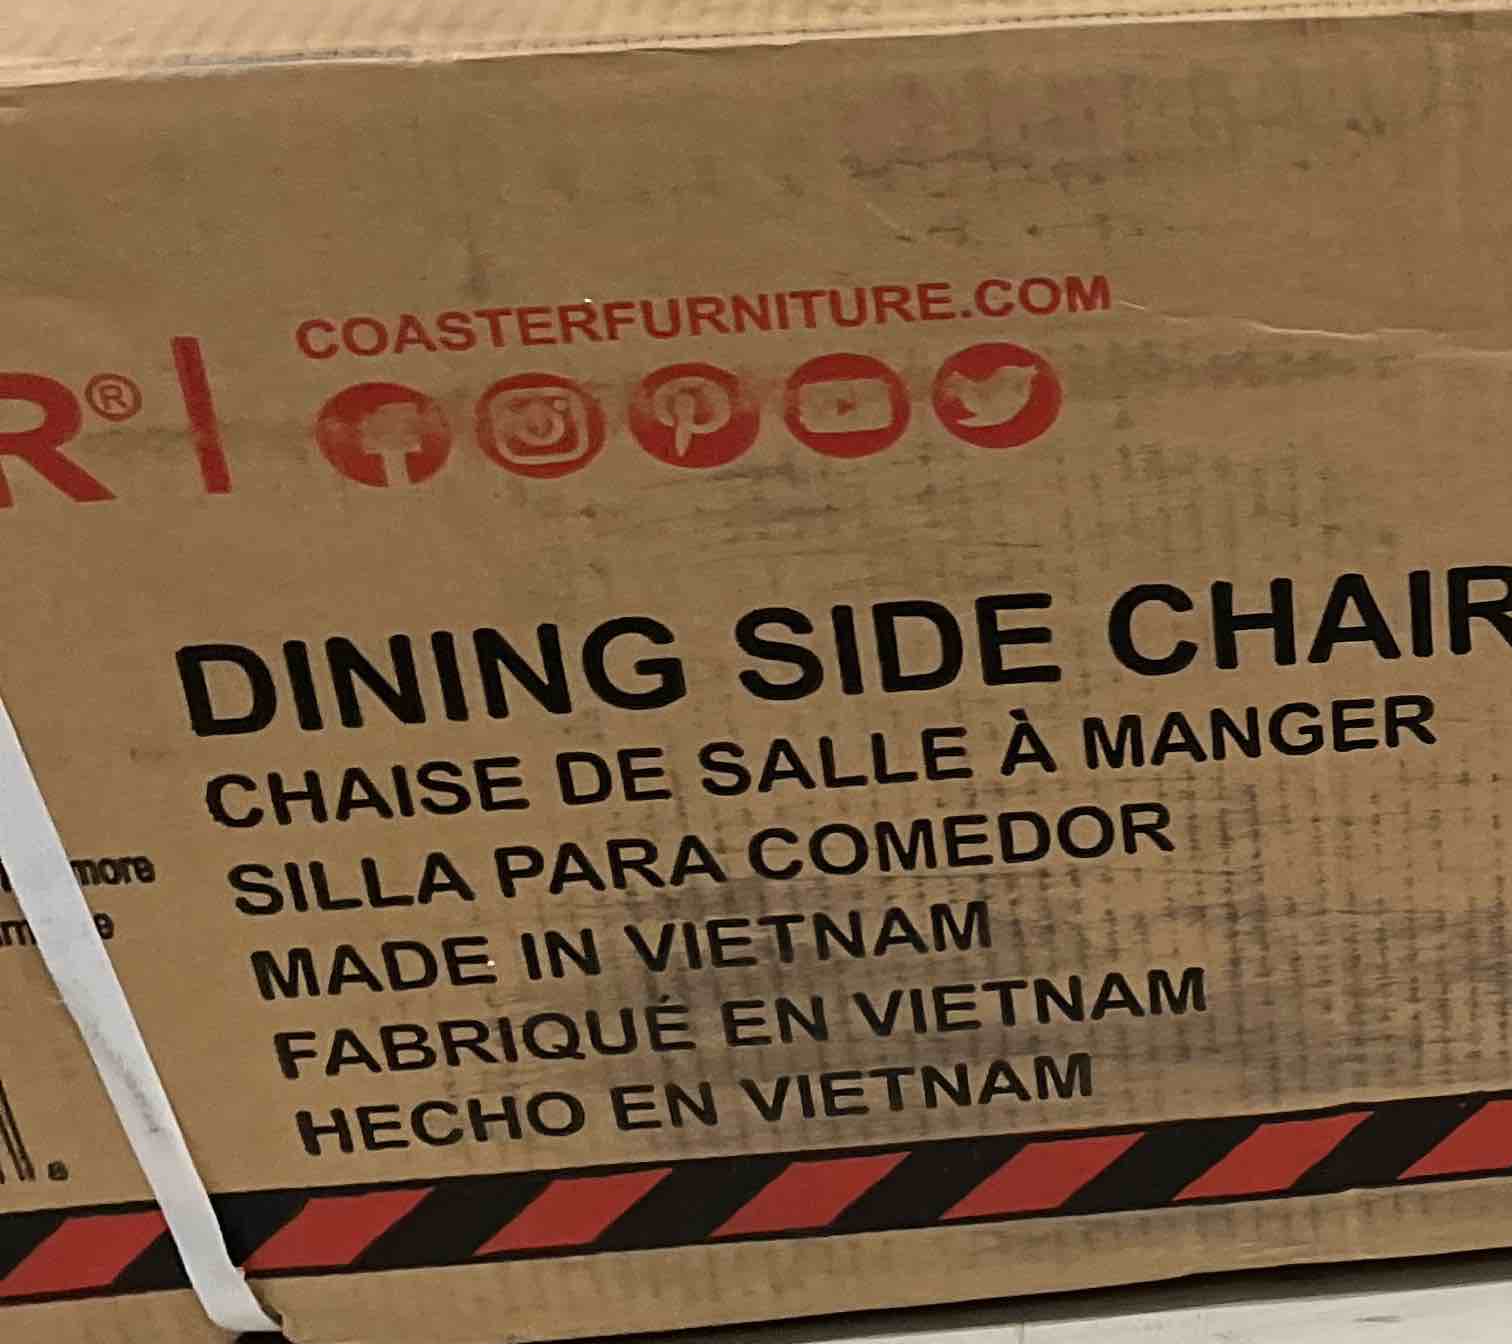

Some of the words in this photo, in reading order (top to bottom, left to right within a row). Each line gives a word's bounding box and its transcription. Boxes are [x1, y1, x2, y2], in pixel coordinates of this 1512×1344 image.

[295, 272, 1114, 362] COASTERFURNITURE.COM
[175, 615, 687, 738] DINING
[736, 592, 1062, 702] SIDE
[205, 755, 530, 829] CHAISE
[557, 746, 672, 804] DE
[698, 725, 973, 796] SALLE
[1000, 708, 1057, 777] À
[1082, 694, 1437, 769] MANGER
[228, 851, 476, 917] SILLA
[493, 833, 727, 899] PARA
[748, 802, 1176, 881] COMEDOR
[251, 935, 499, 1001] MADE
[521, 927, 604, 982] IN
[624, 900, 992, 973] VIETNAM
[274, 994, 698, 1080] FABRIQUÉ
[721, 996, 828, 1047] EN
[852, 966, 1207, 1037] VIETNAM
[296, 1091, 586, 1156] HECHO
[611, 1082, 718, 1131] EN
[740, 1052, 1094, 1123] VIETNAM
